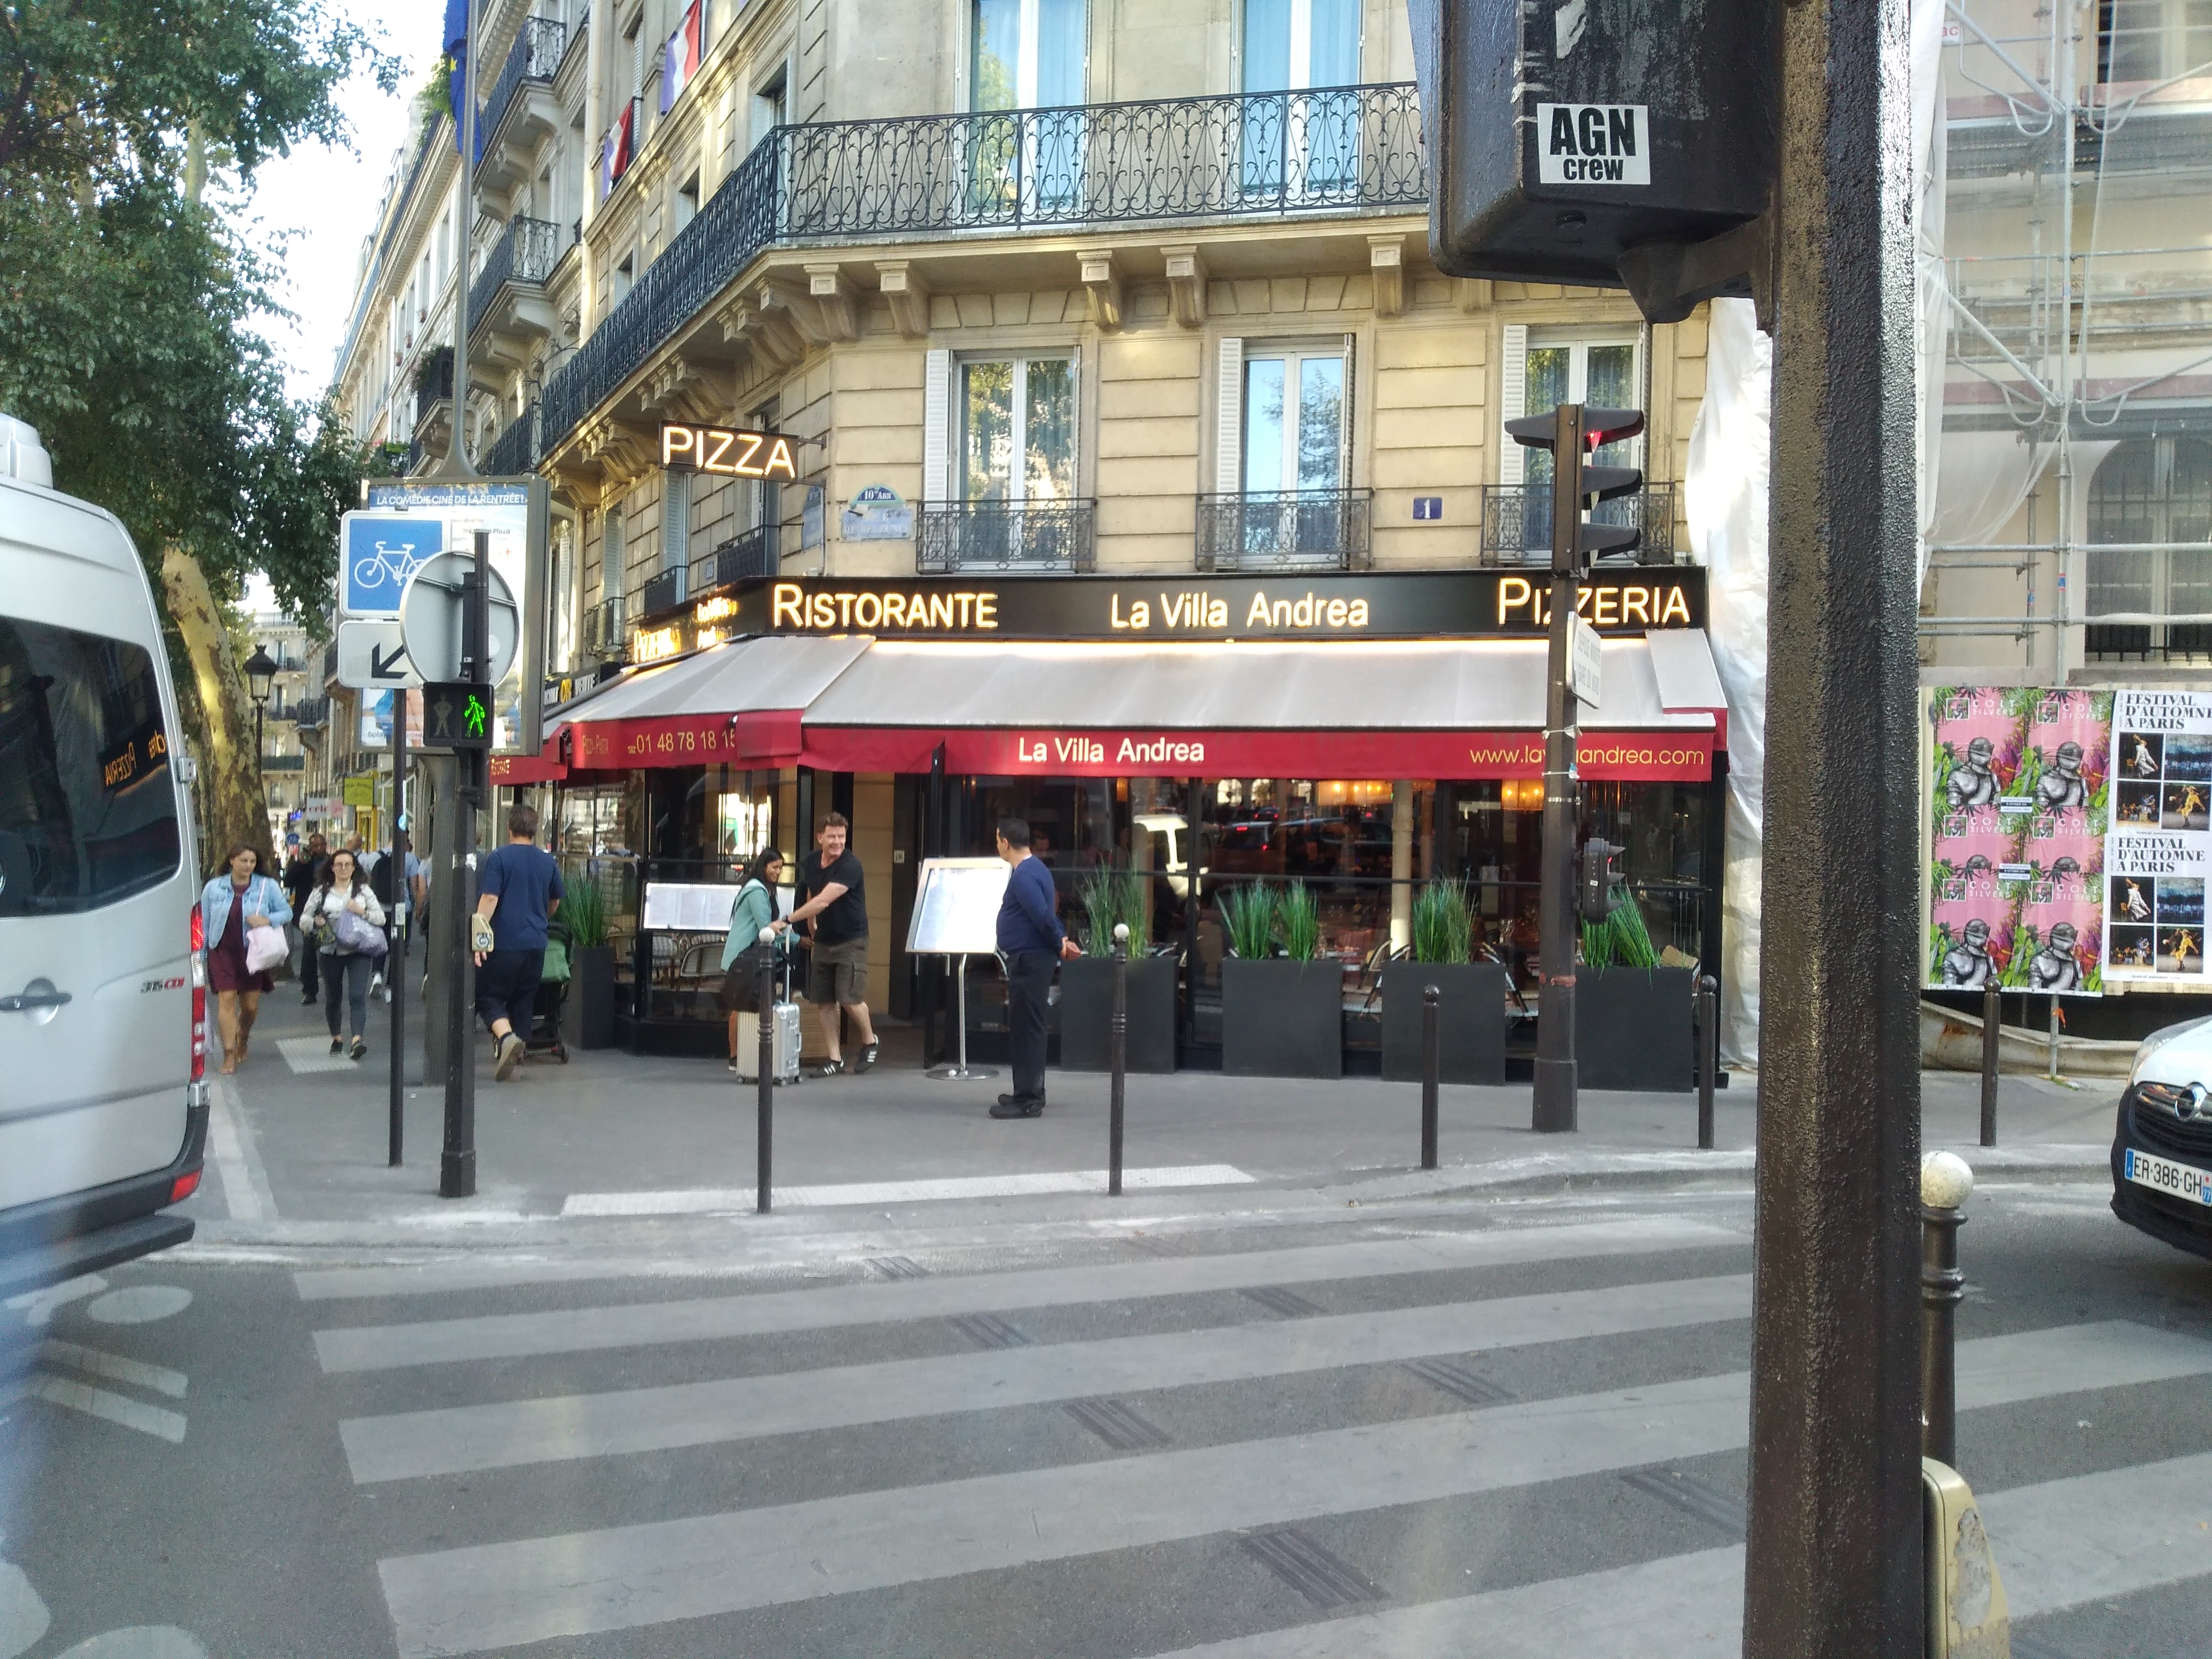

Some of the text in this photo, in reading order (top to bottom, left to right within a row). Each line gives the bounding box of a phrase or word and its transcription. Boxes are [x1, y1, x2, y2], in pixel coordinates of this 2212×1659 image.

[1550, 107, 1636, 156] AGN
[1563, 158, 1623, 180] crew
[663, 426, 795, 479] PIZZA
[377, 496, 388, 505] LA
[389, 494, 430, 505] COMÉDIE
[455, 495, 467, 504] DE
[468, 495, 481, 504] LA
[1423, 499, 1431, 519] 1
[774, 583, 999, 628] RISTORANTE
[1111, 592, 1369, 628] La Villa Andrea
[1973, 699, 2015, 708] COLT
[2126, 693, 2196, 706] FESTIVAL
[2063, 703, 2103, 713] COLT
[2139, 717, 2185, 730] PARIS
[636, 734, 652, 753] 01
[657, 732, 674, 752] 48
[677, 732, 695, 751] 78
[700, 731, 716, 750] 18
[1019, 737, 1204, 763] La Villa Andrea
[1971, 816, 2012, 825] COLT
[2058, 818, 2099, 827] COLT
[2117, 837, 2186, 849] FESTIVAL
[2118, 849, 2206, 862] D'AUTOMNE
[2130, 861, 2175, 873] PARIS
[1970, 881, 2010, 890] COLT
[2057, 884, 2098, 894] COLT
[2134, 1157, 2202, 1196] ER-386-GH
